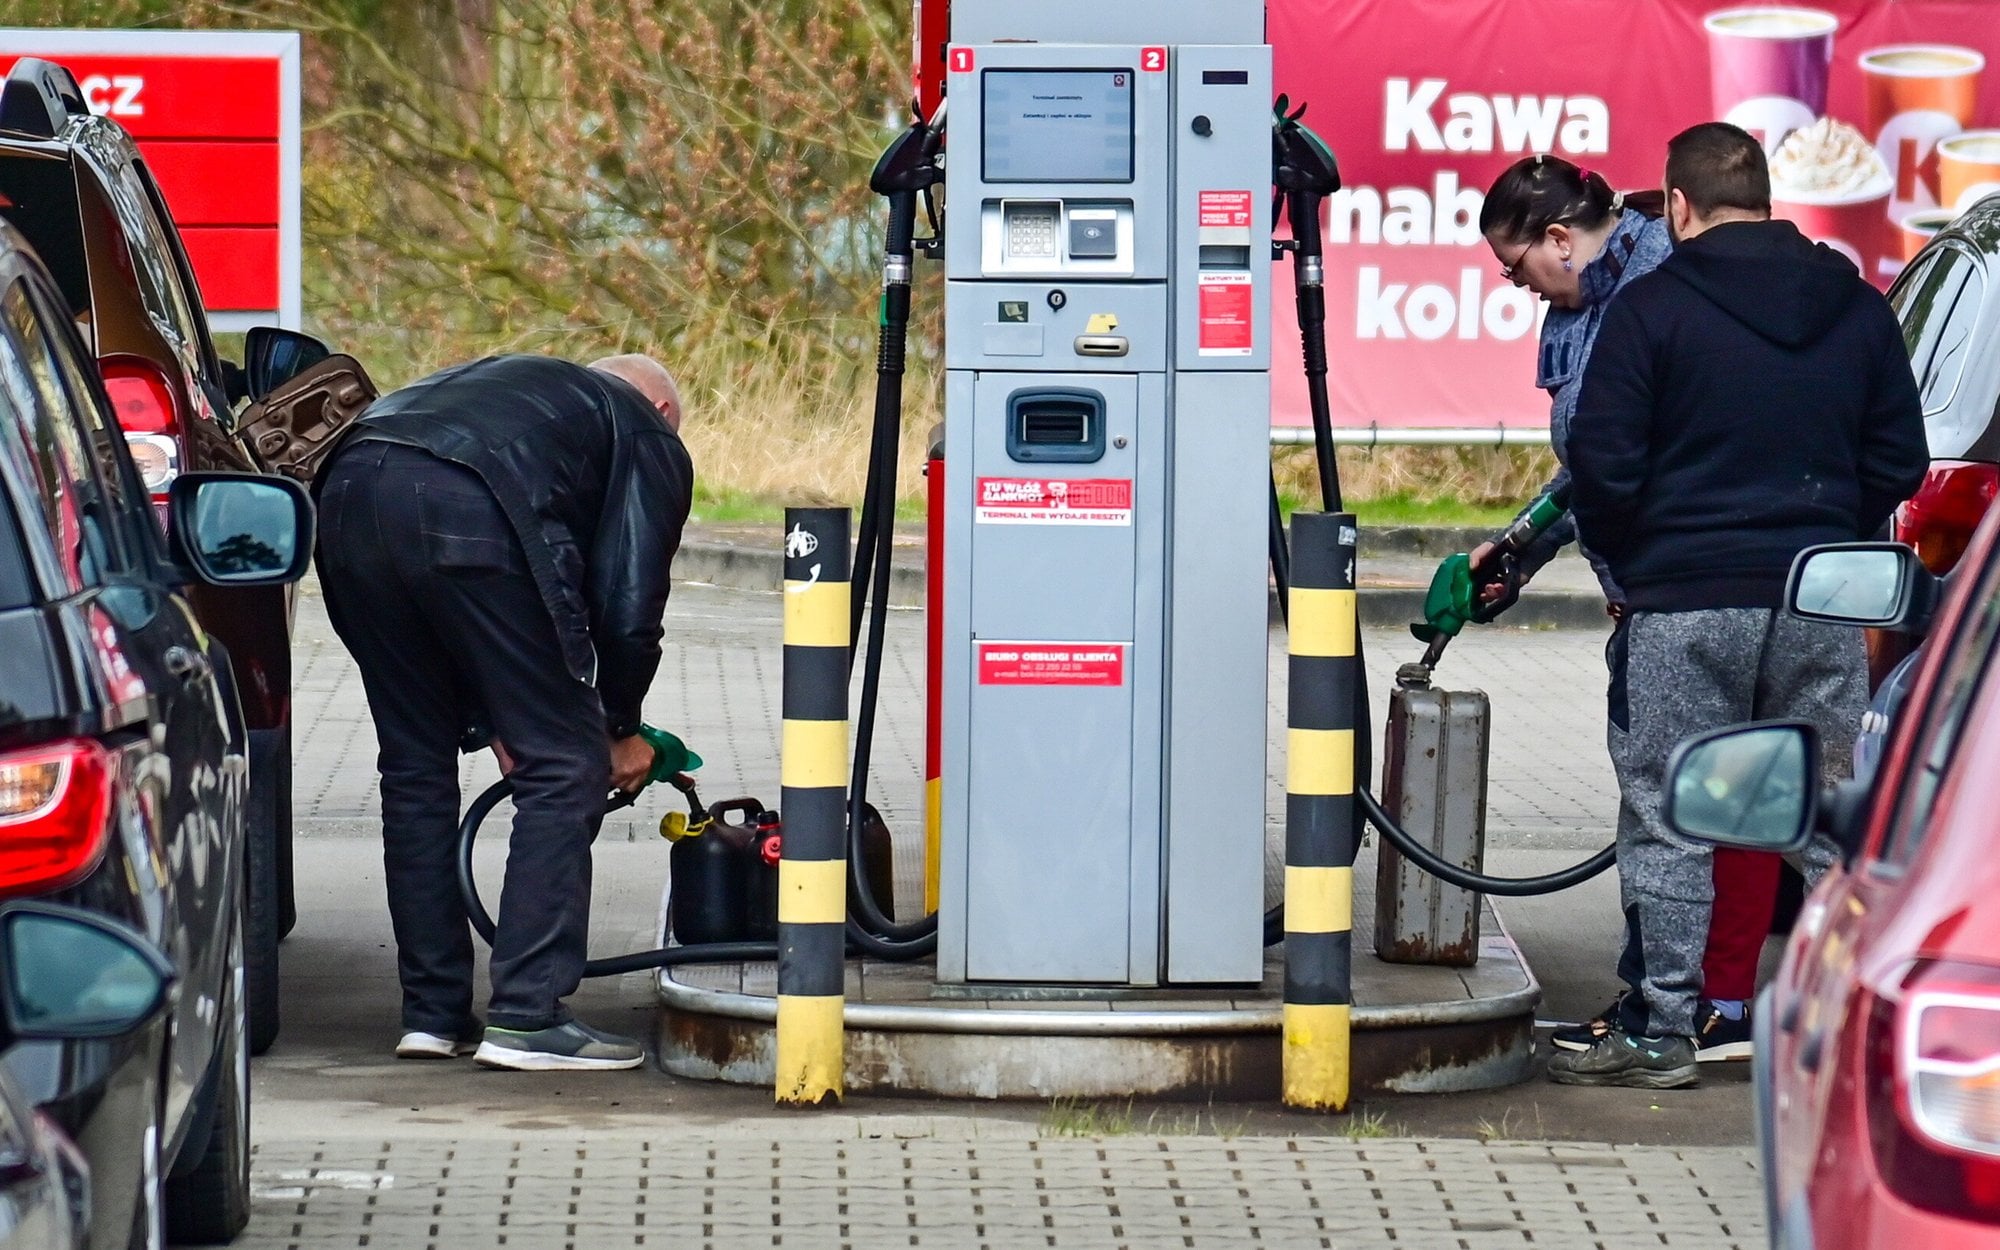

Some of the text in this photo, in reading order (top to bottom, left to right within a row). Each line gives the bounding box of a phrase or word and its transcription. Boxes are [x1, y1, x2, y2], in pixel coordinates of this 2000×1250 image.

[956, 53, 966, 68] 1
[1146, 52, 1160, 68] 2
[80, 75, 144, 116] CZ
[1384, 77, 1610, 154] Kawa
[1328, 171, 1484, 247] nab
[1356, 265, 1549, 341] kolo
[983, 482, 1002, 493] TU
[982, 511, 1028, 519] TERMINAL
[1049, 512, 1088, 520] WYDAJE
[1090, 513, 1126, 521] RESZTY
[985, 652, 1019, 662] BIURO
[1072, 653, 1118, 662] KLIENTA
